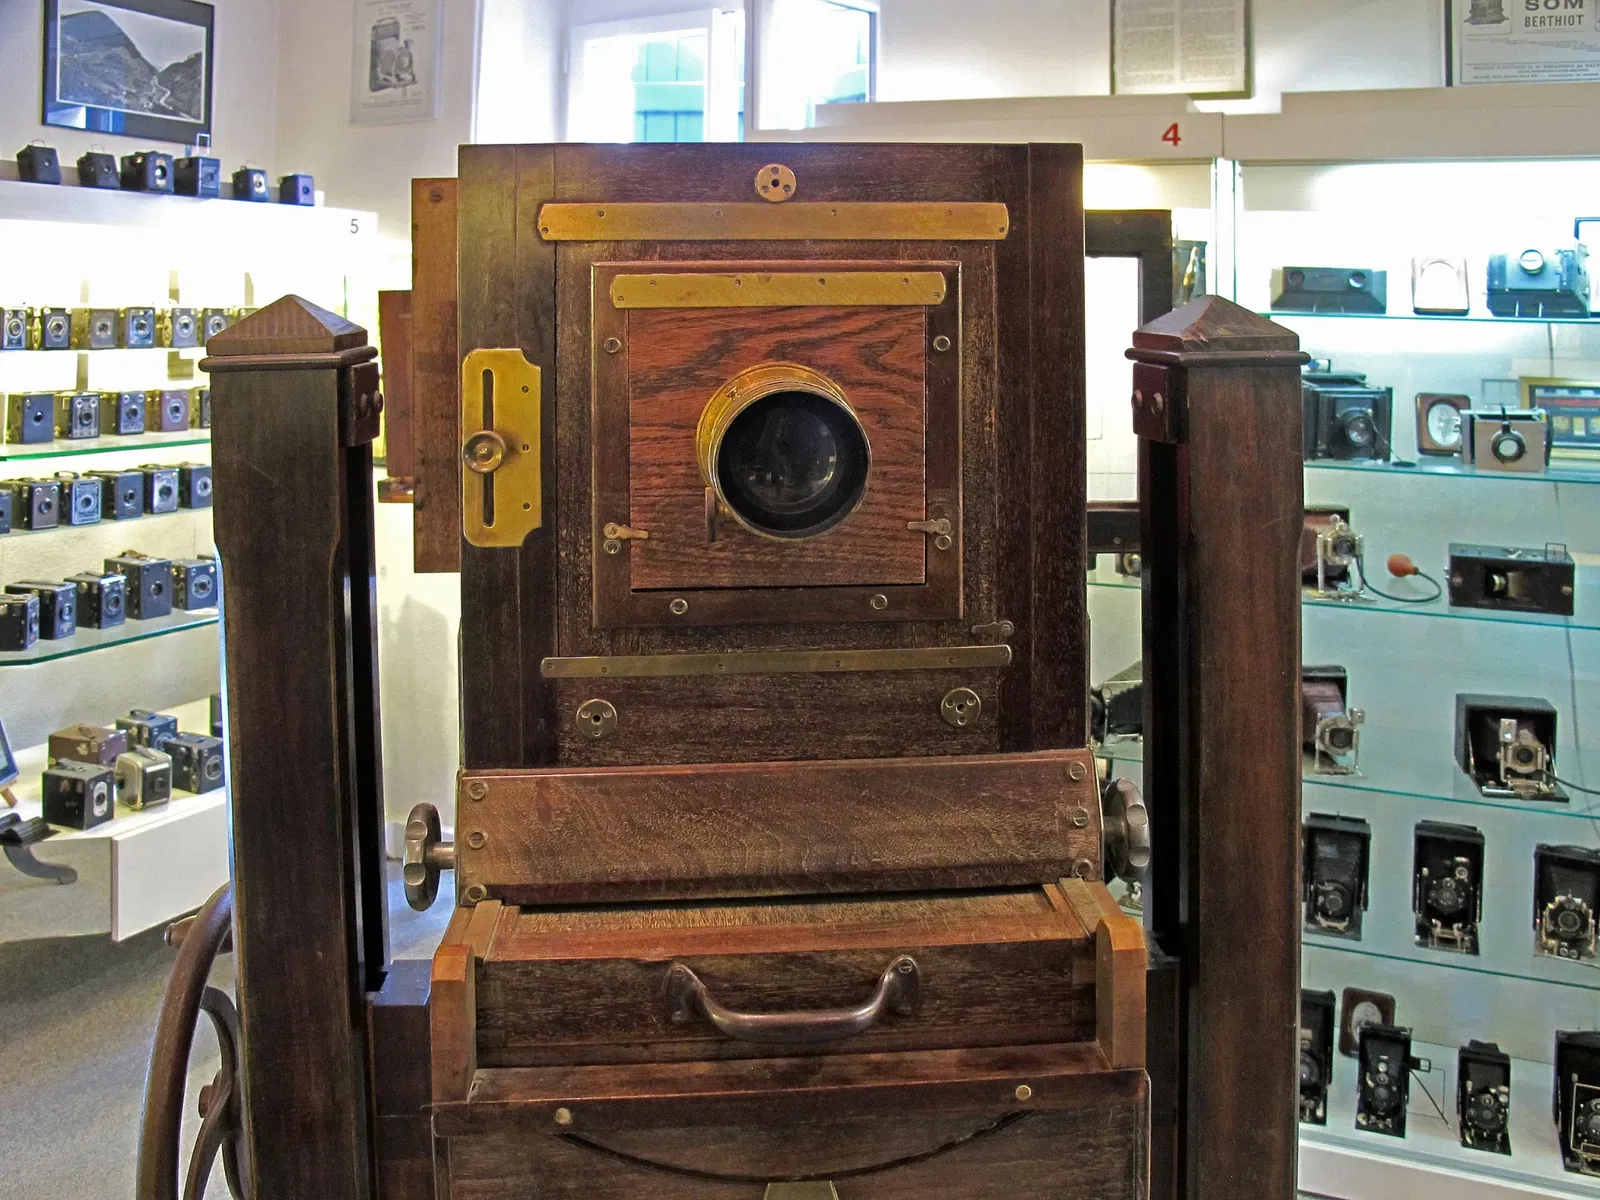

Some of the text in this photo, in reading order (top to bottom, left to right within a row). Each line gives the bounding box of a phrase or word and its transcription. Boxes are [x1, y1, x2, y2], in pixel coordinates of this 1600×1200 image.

[1524, 0, 1584, 11] SOM
[1524, 14, 1584, 28] BERTHIOT
[1162, 123, 1181, 146] 4
[350, 219, 359, 234] 5
